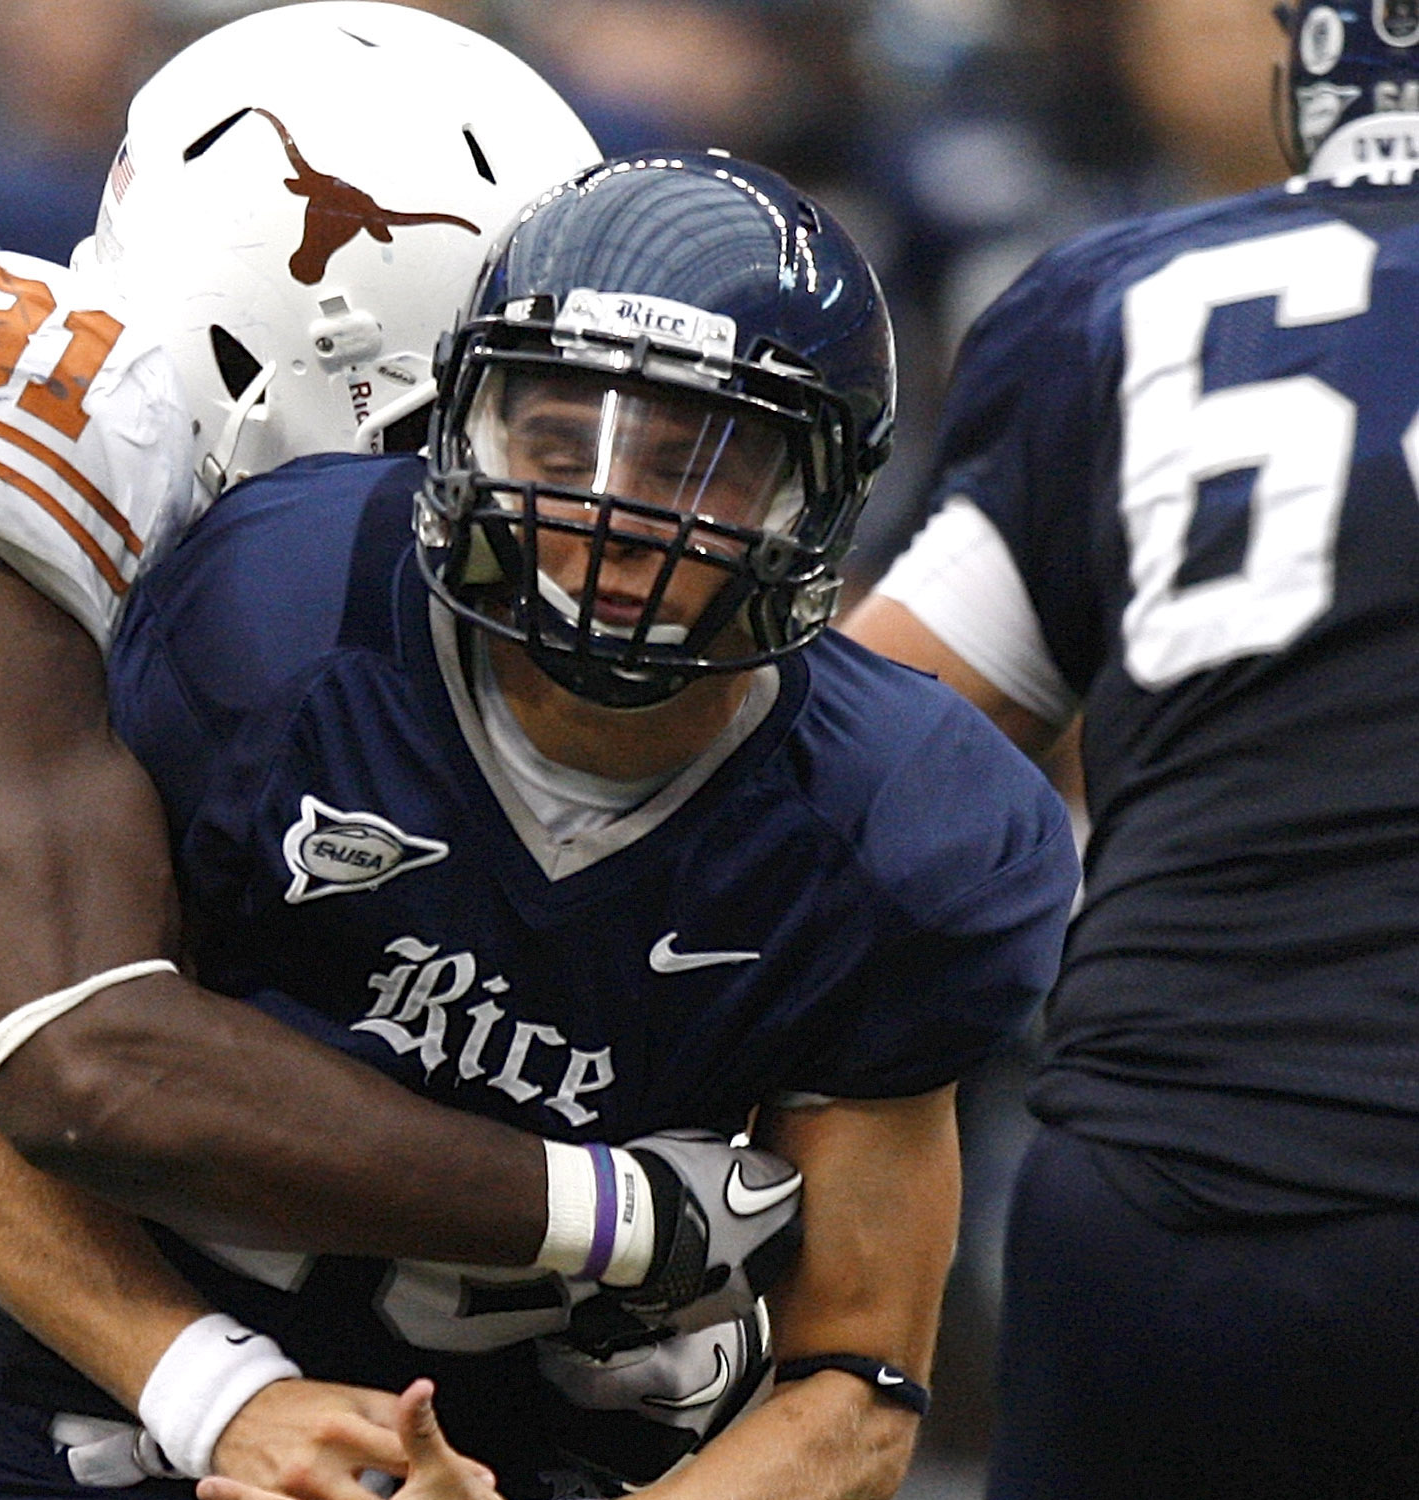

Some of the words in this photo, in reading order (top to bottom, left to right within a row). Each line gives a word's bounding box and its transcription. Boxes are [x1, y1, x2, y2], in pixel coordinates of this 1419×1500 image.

[615, 298, 686, 335] Rice
[1118, 219, 1419, 692] 6
[349, 936, 616, 1127] Rice
